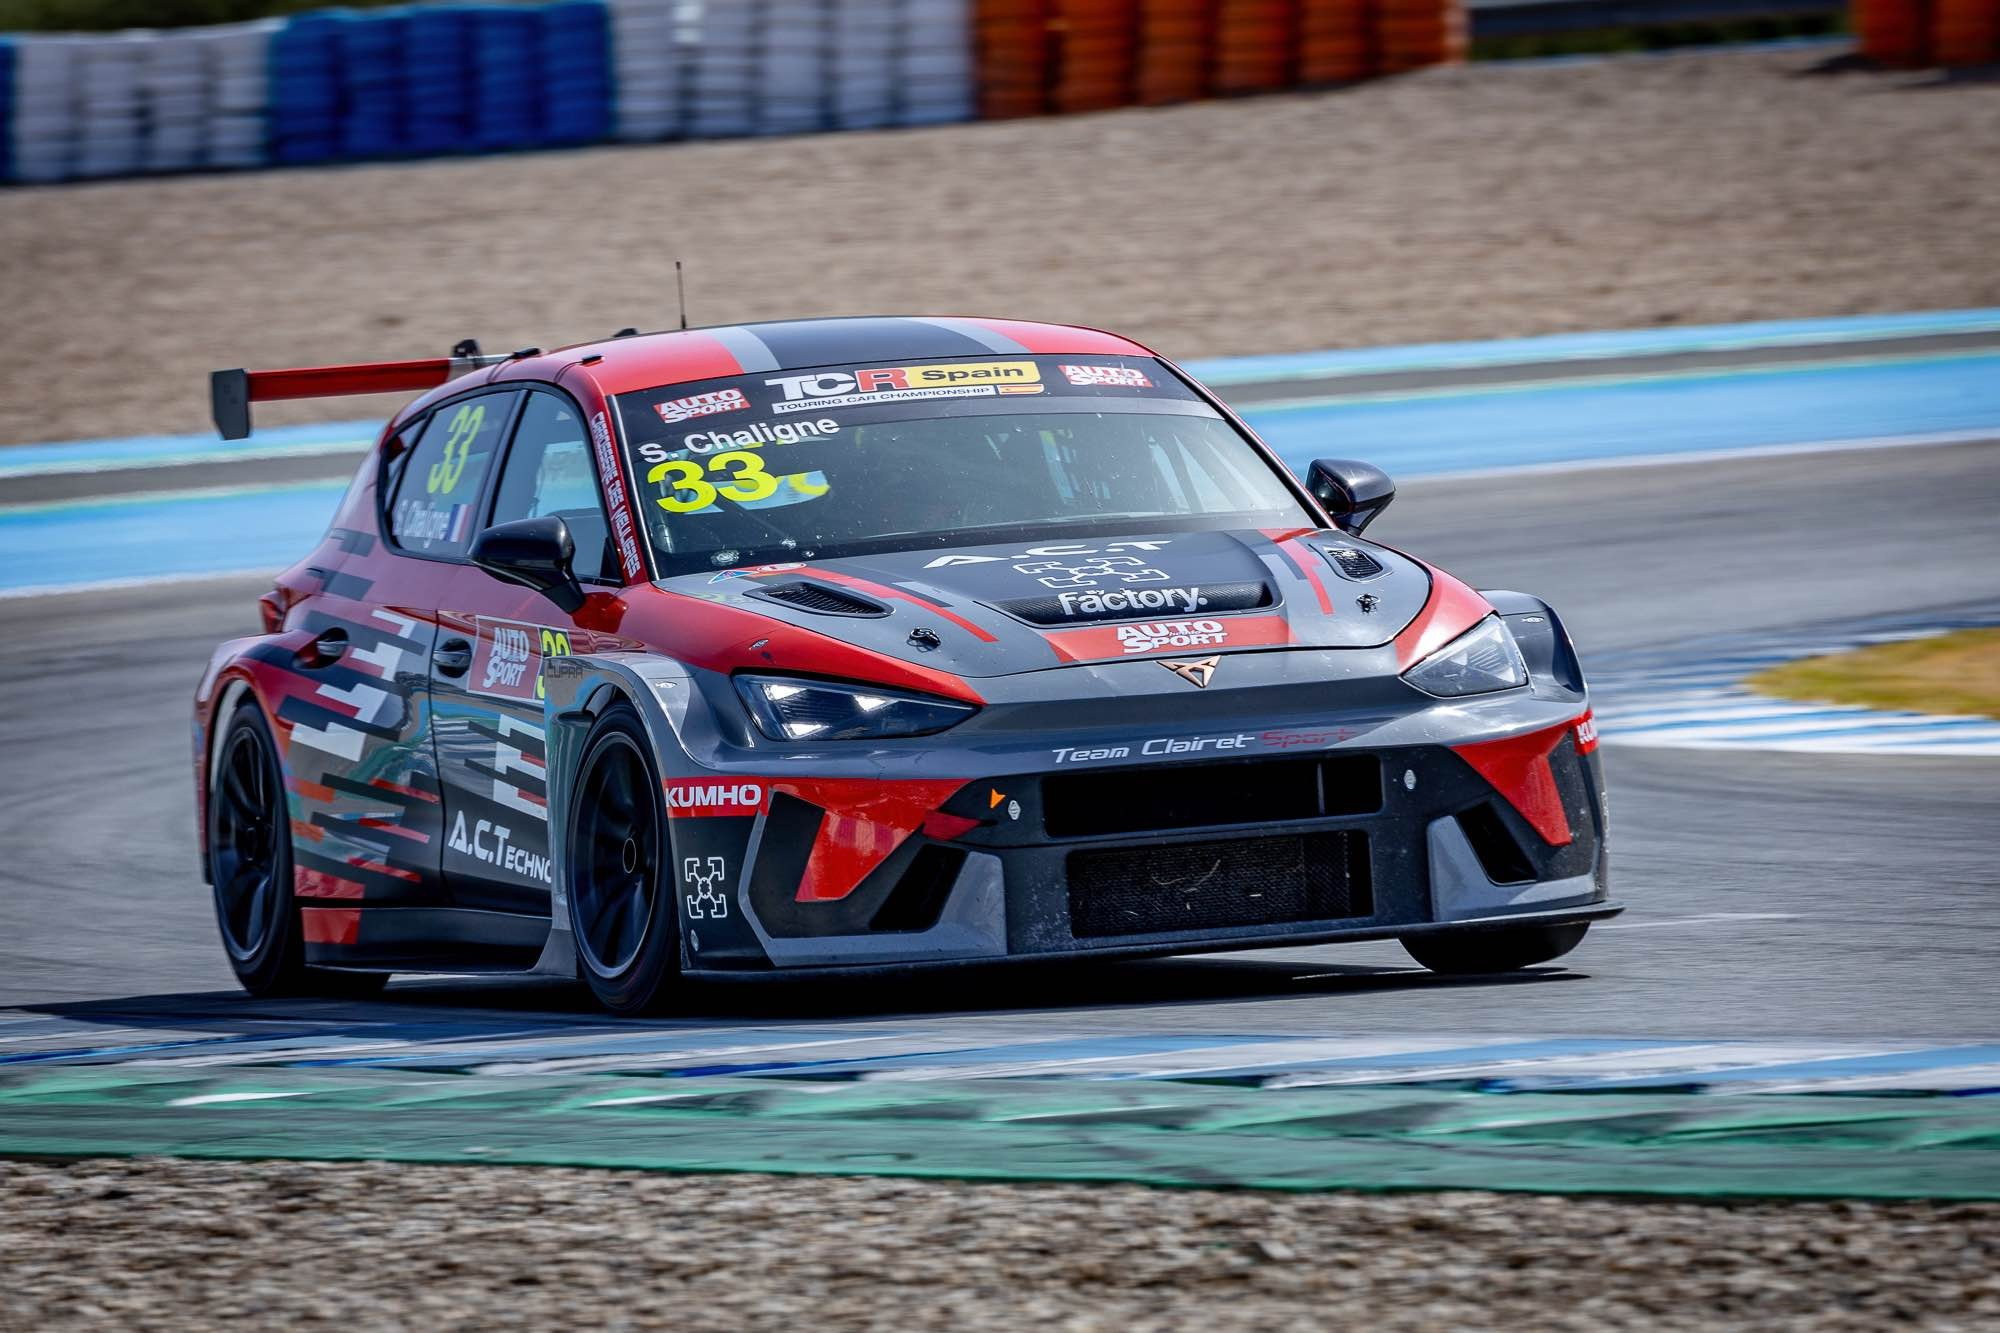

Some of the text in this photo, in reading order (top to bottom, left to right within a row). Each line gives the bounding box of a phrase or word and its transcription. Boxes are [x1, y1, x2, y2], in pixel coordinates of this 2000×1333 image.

[765, 367, 1024, 400] TCR Spain
[1065, 366, 1143, 379] AUTO
[1070, 373, 1147, 386] SPORT
[660, 389, 741, 415] AUTO
[664, 399, 744, 424] SPORT
[778, 387, 990, 410] TOURING CAR CHAMPIONSHIP
[427, 405, 486, 494] 33
[638, 418, 841, 463] S. Chaligne
[647, 451, 777, 513] 33
[1117, 620, 1223, 640] AUTO
[1123, 632, 1227, 653] SPORT
[490, 627, 530, 662] AUTO
[482, 656, 527, 688] SPORT
[1052, 727, 1357, 763] Team Clairet Sport
[666, 784, 762, 808] KUMHO
